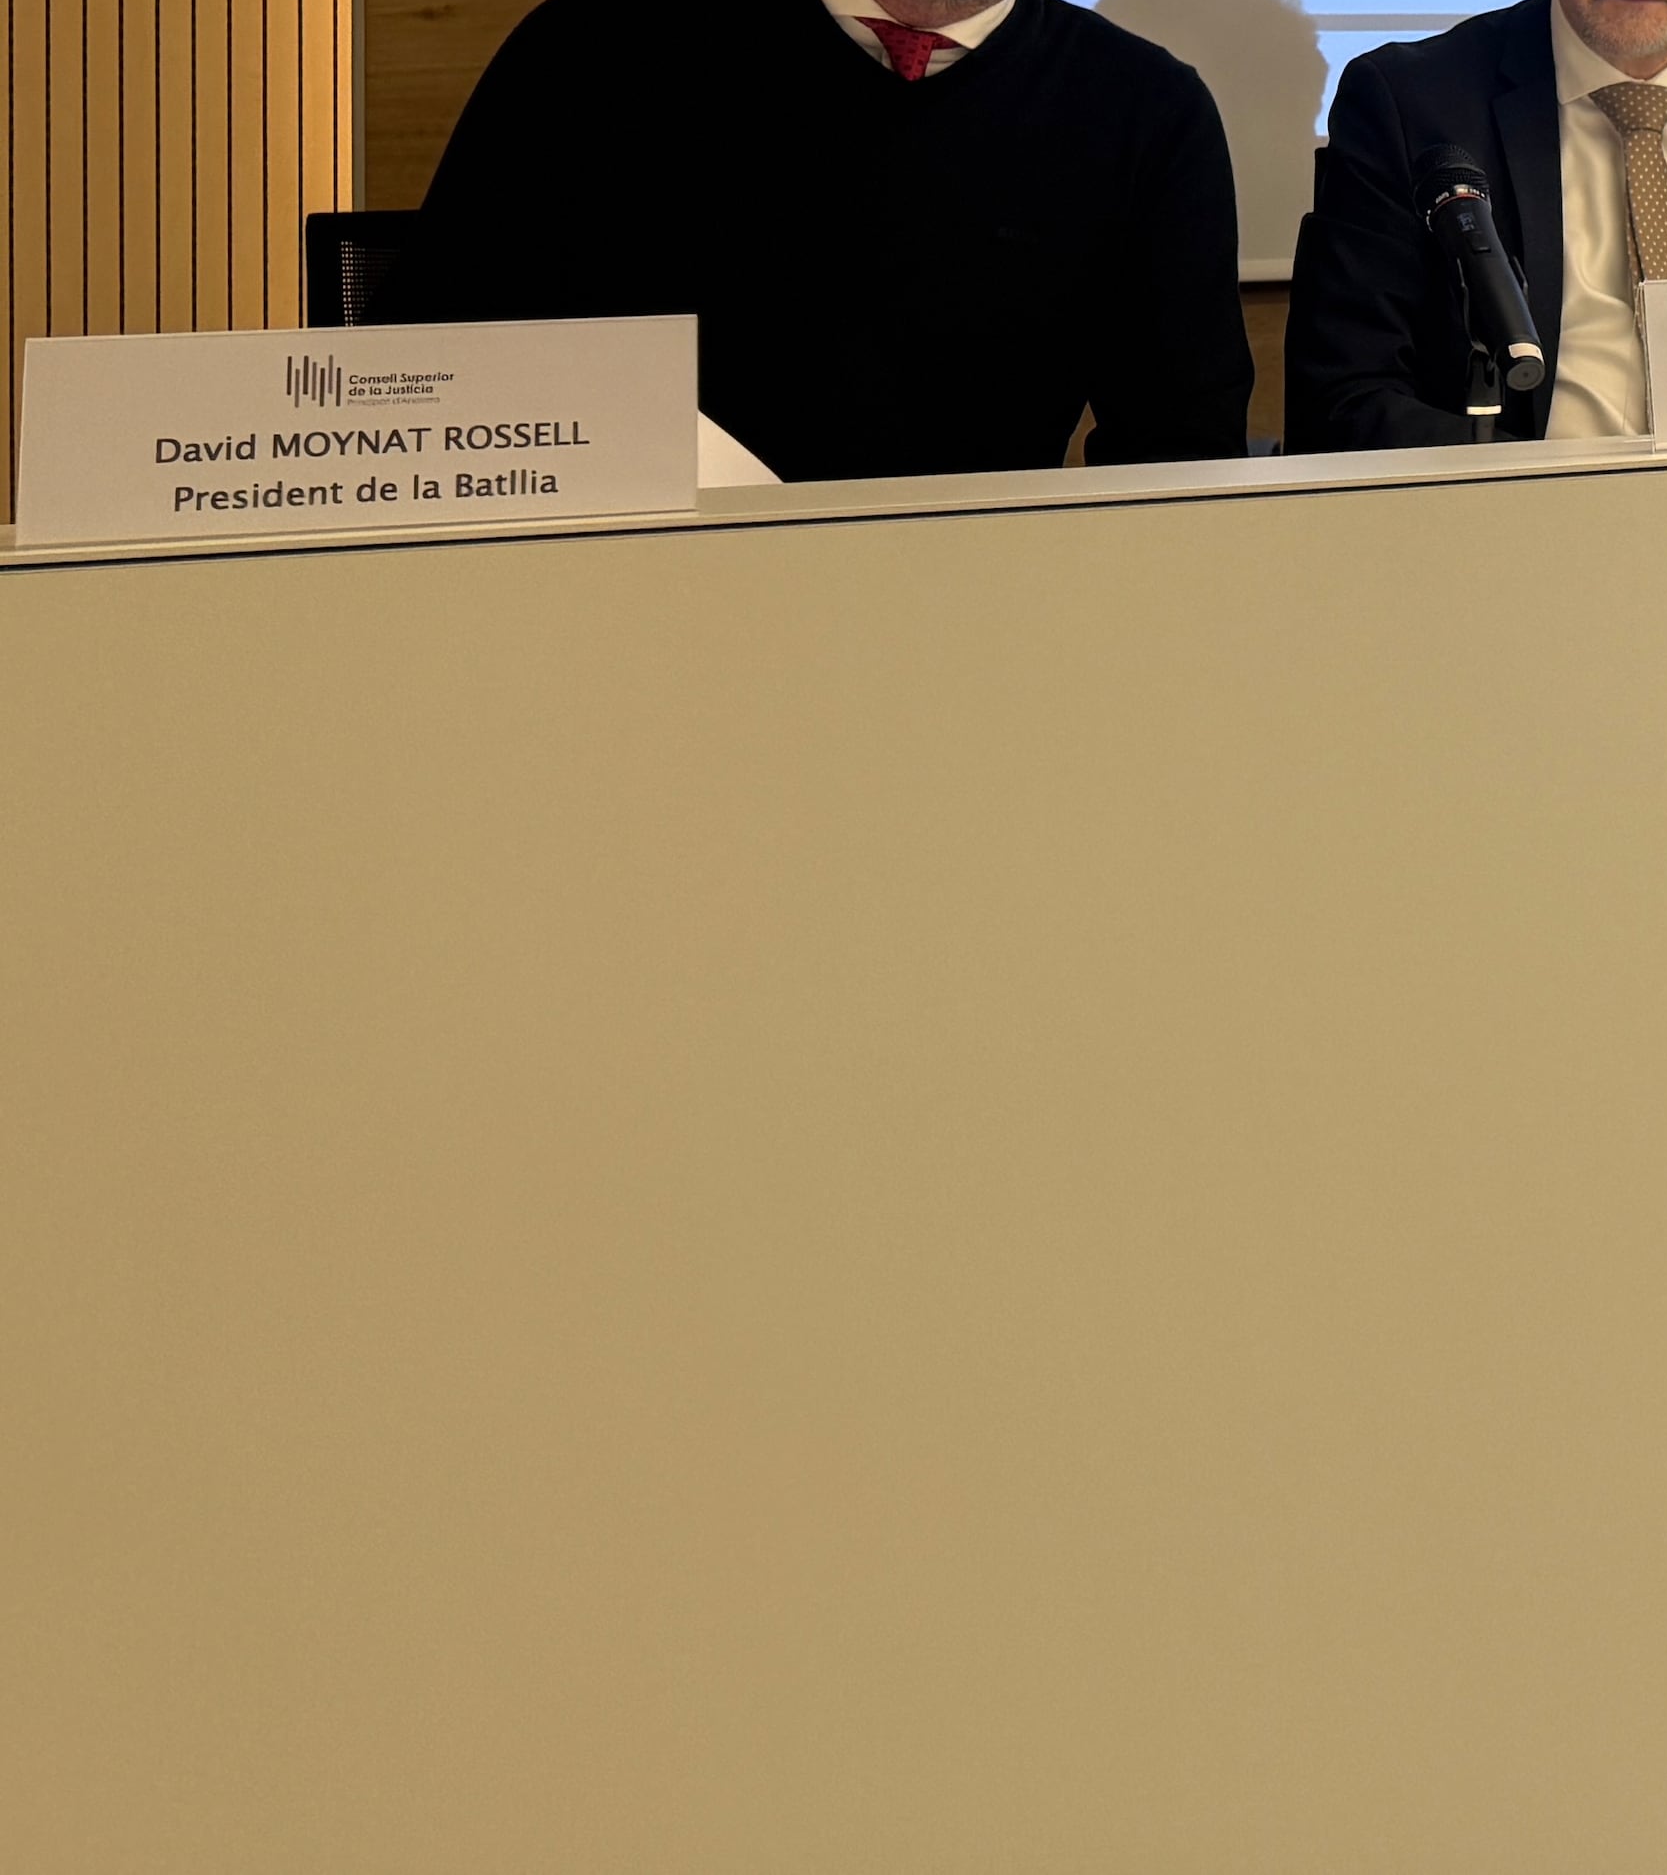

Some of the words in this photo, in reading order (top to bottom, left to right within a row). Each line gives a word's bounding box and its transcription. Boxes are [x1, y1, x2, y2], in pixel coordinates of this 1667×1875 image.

[348, 385, 366, 396] de
[370, 385, 382, 396] la
[385, 383, 434, 395] Justícia
[349, 373, 397, 385] Consell
[400, 371, 454, 384] Superior
[155, 433, 256, 464] David
[272, 427, 432, 459] MOYNAT
[444, 421, 590, 451] ROSSELL
[174, 480, 343, 512] President
[356, 476, 398, 503] de
[413, 474, 442, 500] la
[455, 469, 559, 498] Batllia
